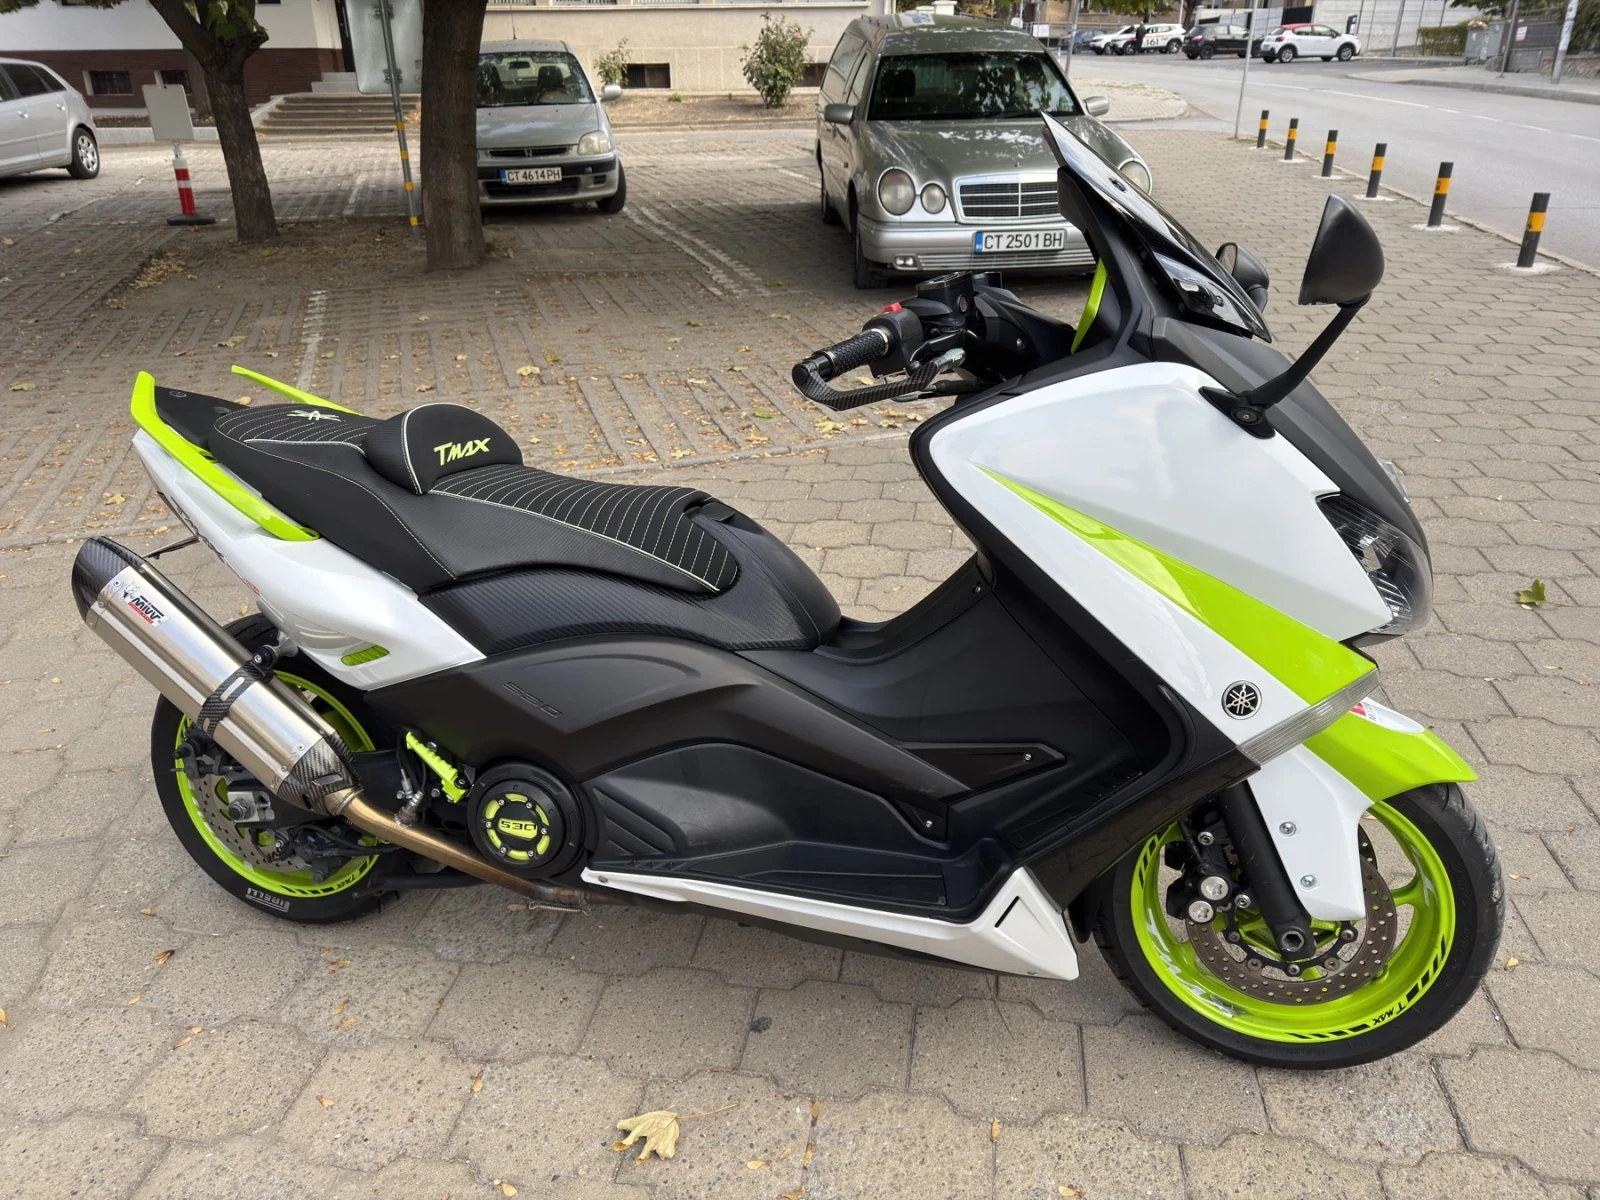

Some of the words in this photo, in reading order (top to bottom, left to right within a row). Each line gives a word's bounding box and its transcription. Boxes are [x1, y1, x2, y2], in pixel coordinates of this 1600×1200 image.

[507, 171, 520, 182] CT
[522, 170, 545, 181] 4614
[984, 234, 1003, 250] CT
[1006, 233, 1040, 249] 2501
[1043, 232, 1063, 248] BH
[433, 437, 491, 467] TMAX
[501, 820, 537, 832] 530
[245, 886, 291, 913] PIRELLI
